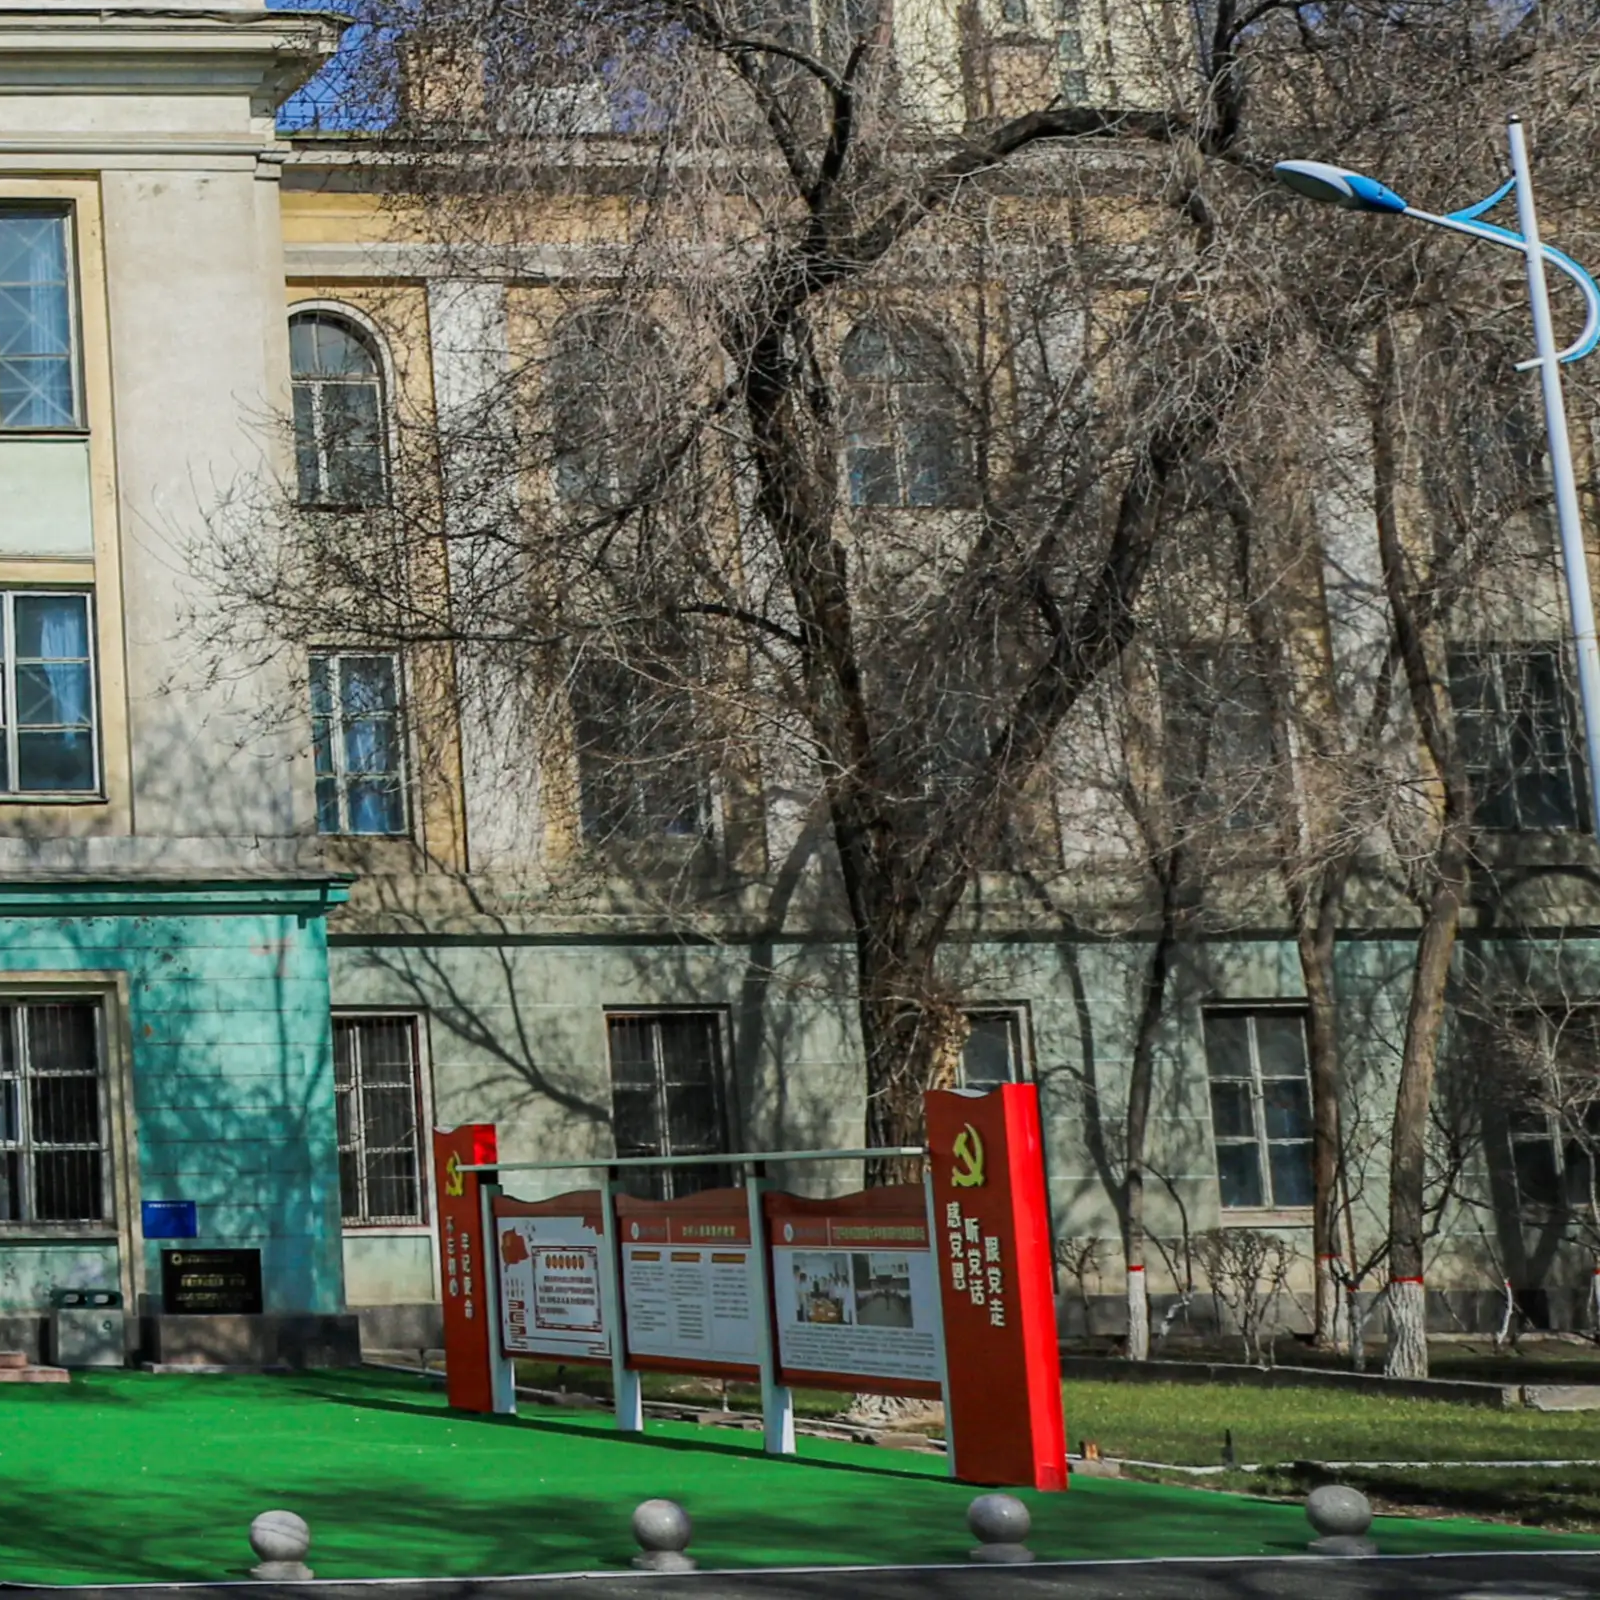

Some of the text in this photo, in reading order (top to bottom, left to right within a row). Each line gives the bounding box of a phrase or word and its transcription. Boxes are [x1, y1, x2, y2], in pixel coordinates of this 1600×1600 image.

[946, 1201, 967, 1291] 感党恩
[964, 1217, 986, 1306] 听党话
[984, 1236, 1006, 1327] 跟党走
